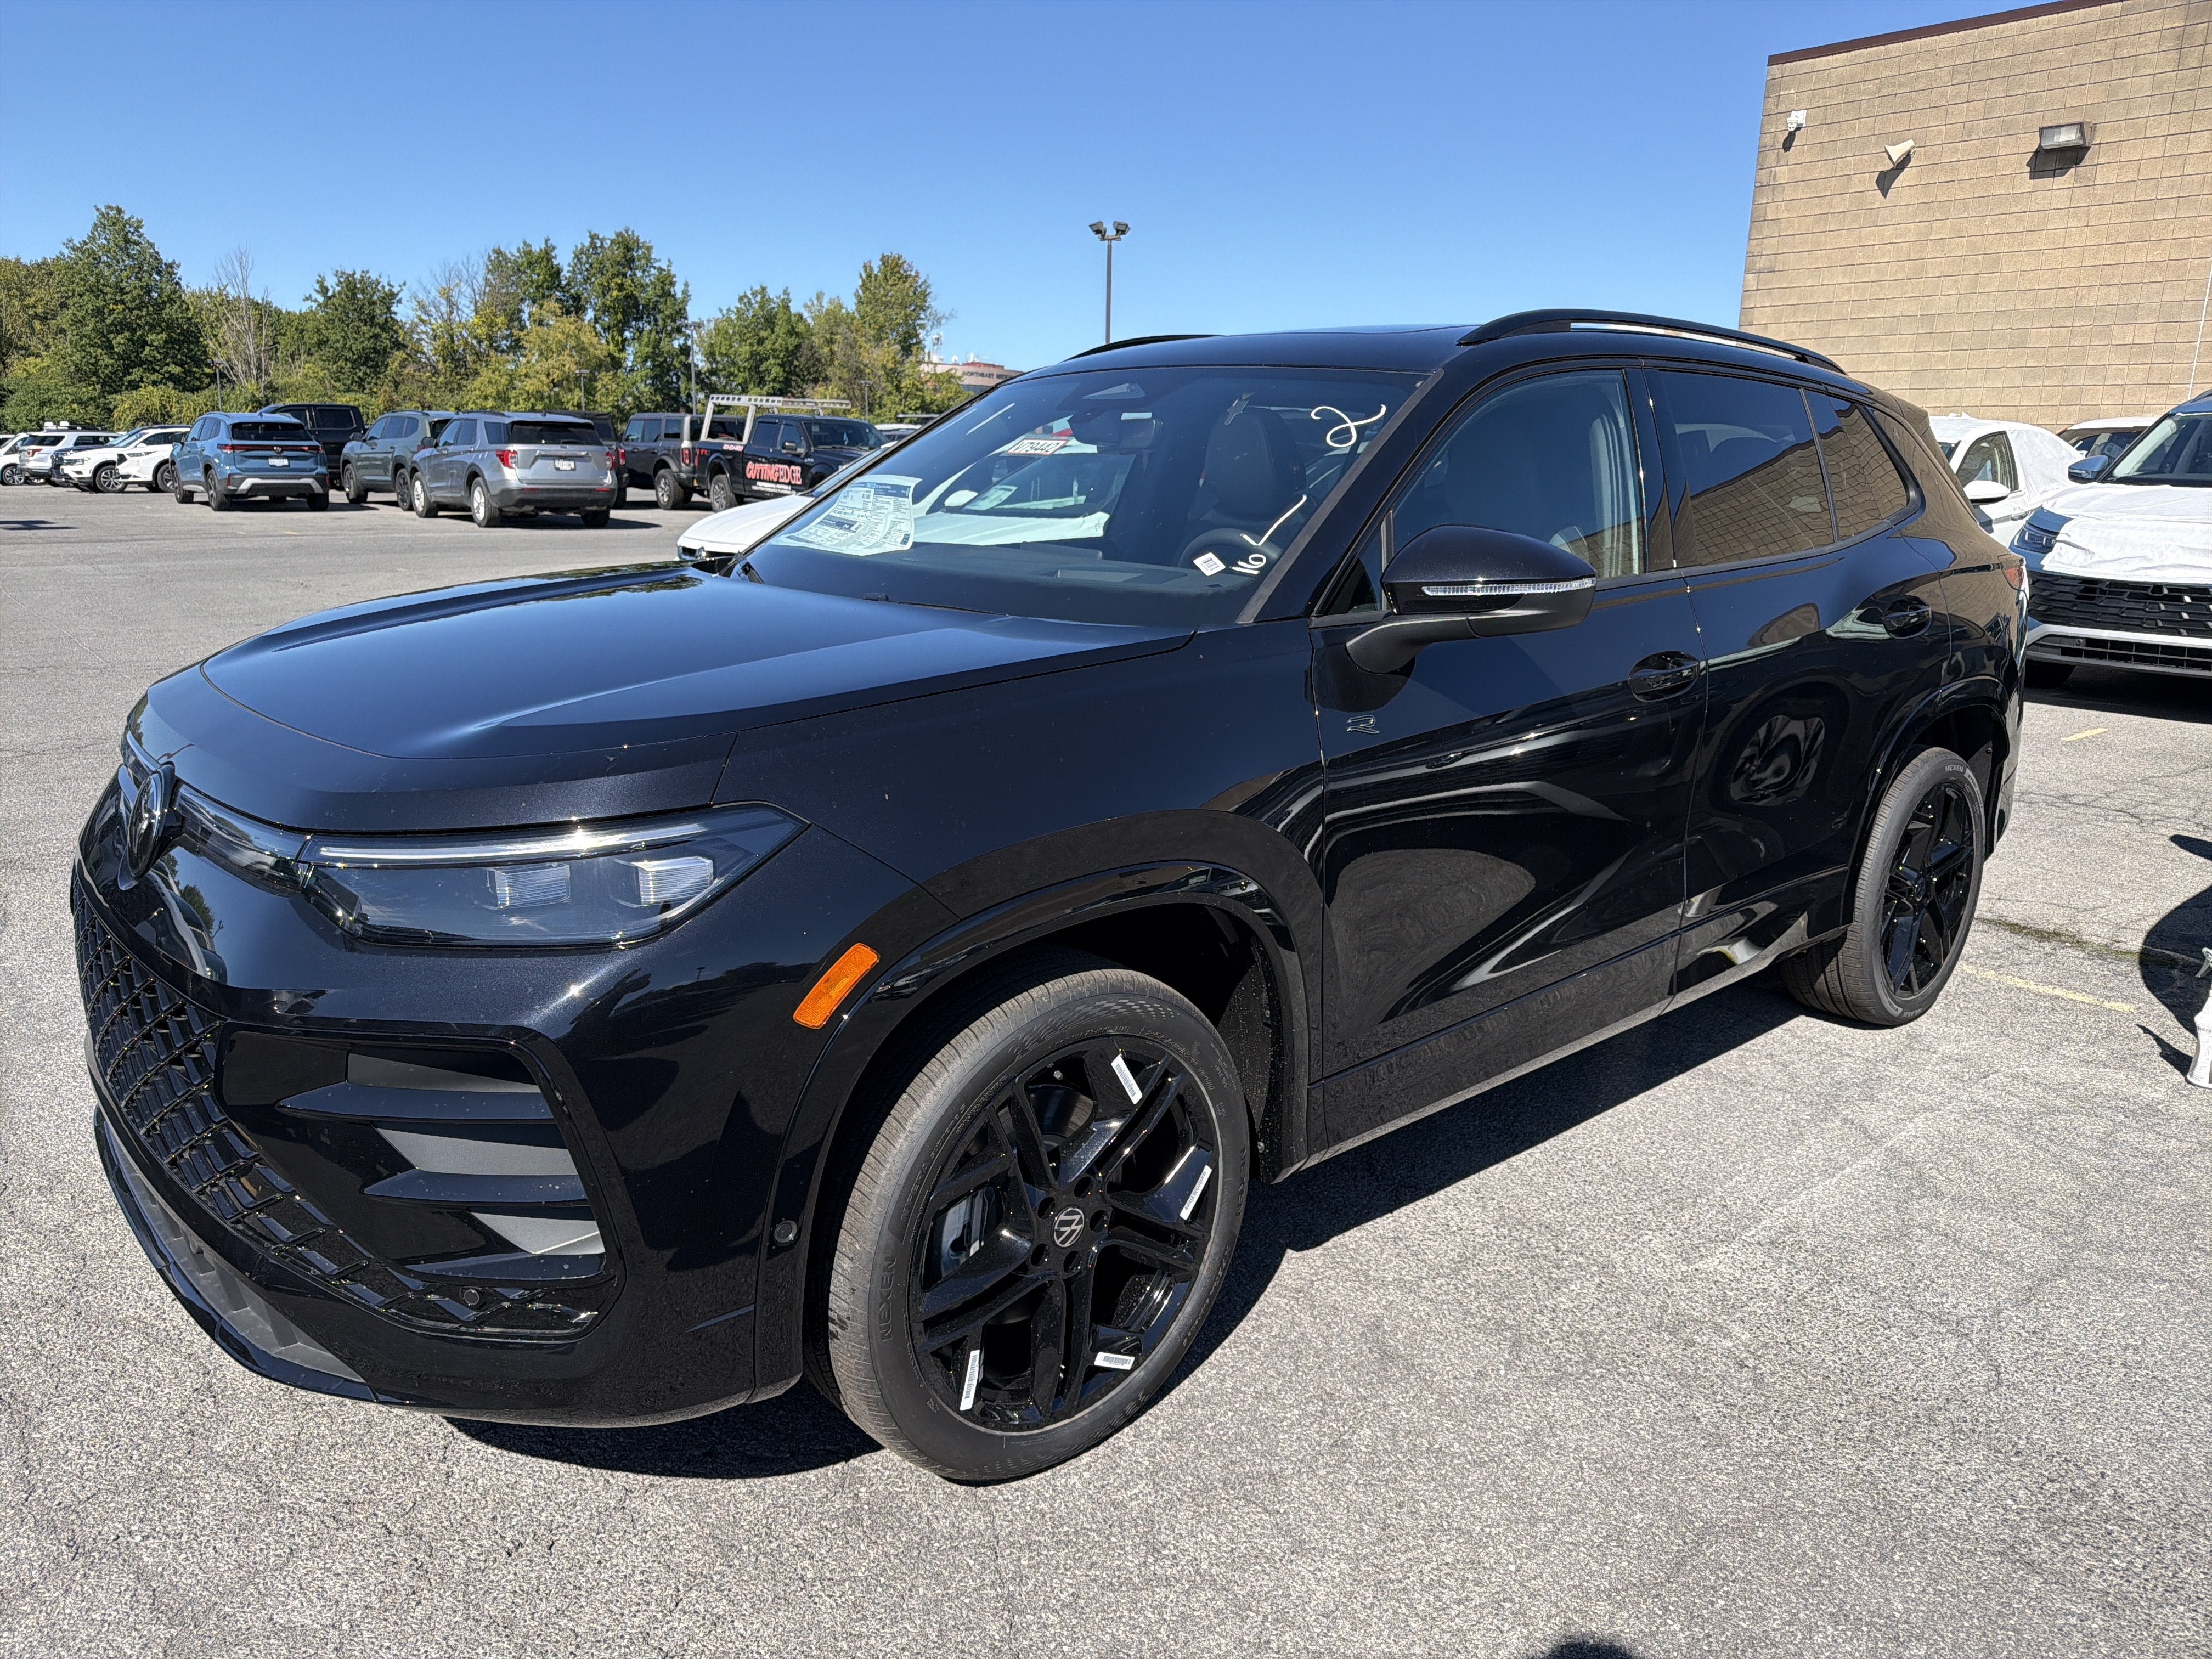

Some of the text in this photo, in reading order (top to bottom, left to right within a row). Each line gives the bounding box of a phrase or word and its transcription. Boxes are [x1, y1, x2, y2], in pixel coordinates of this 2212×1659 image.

[1013, 441, 1060, 453] V79442
[746, 461, 802, 485] CUTTING EDGE
[1229, 554, 1267, 575] 16
[1311, 404, 1387, 448] 2
[1346, 715, 1380, 734] R
[1945, 764, 1963, 773] NEXEN
[1235, 1146, 1247, 1217] NEXEN
[879, 1255, 897, 1342] NEXEN
